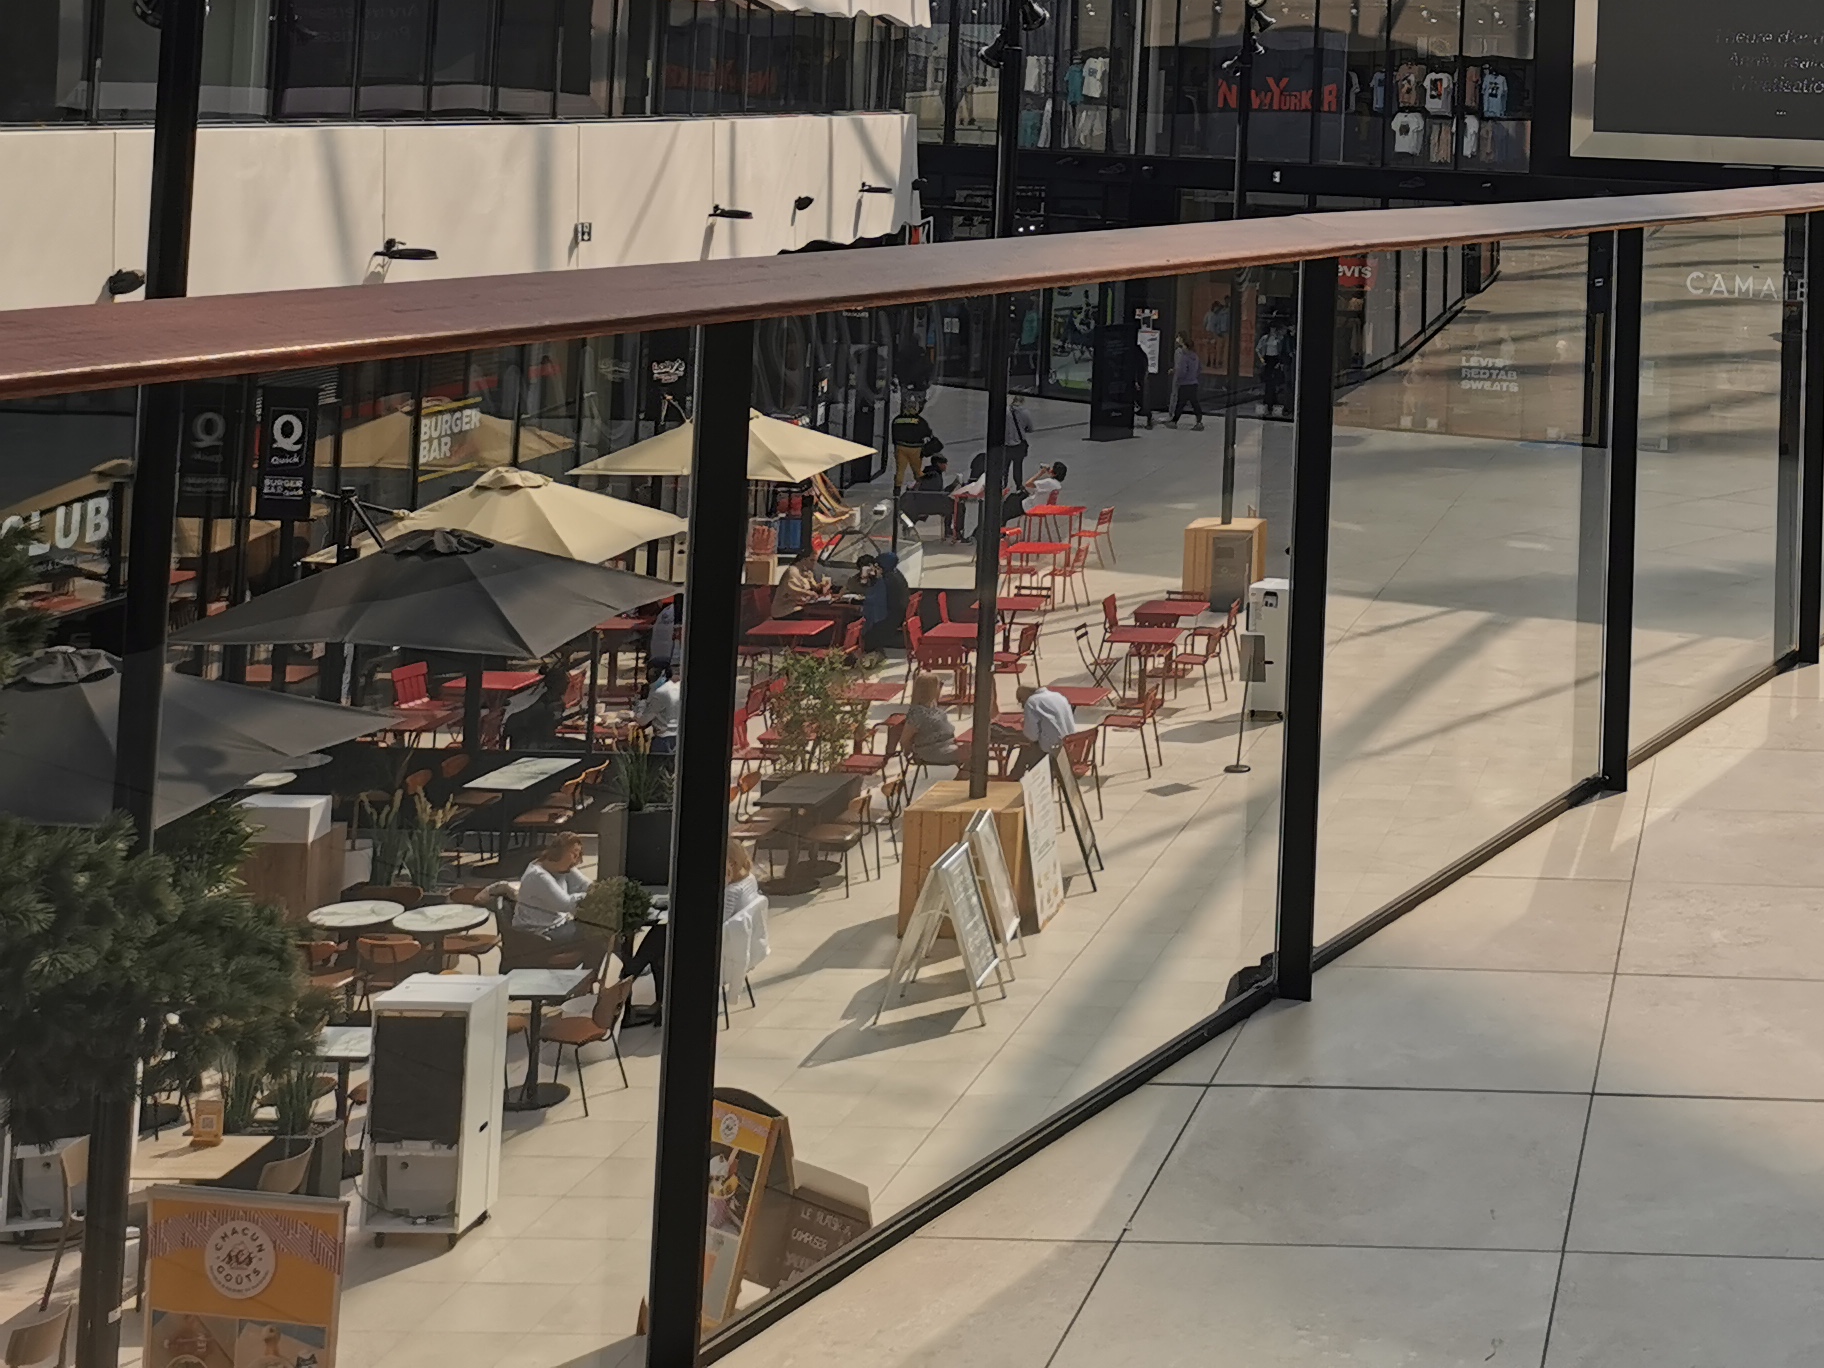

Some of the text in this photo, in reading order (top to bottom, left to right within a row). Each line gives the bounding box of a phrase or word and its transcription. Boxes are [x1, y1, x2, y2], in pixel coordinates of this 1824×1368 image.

[1217, 76, 1338, 112] NWYORKR
[420, 407, 481, 441] BURGER
[419, 436, 452, 464] BAR
[214, 1226, 265, 1252] CHACUN
